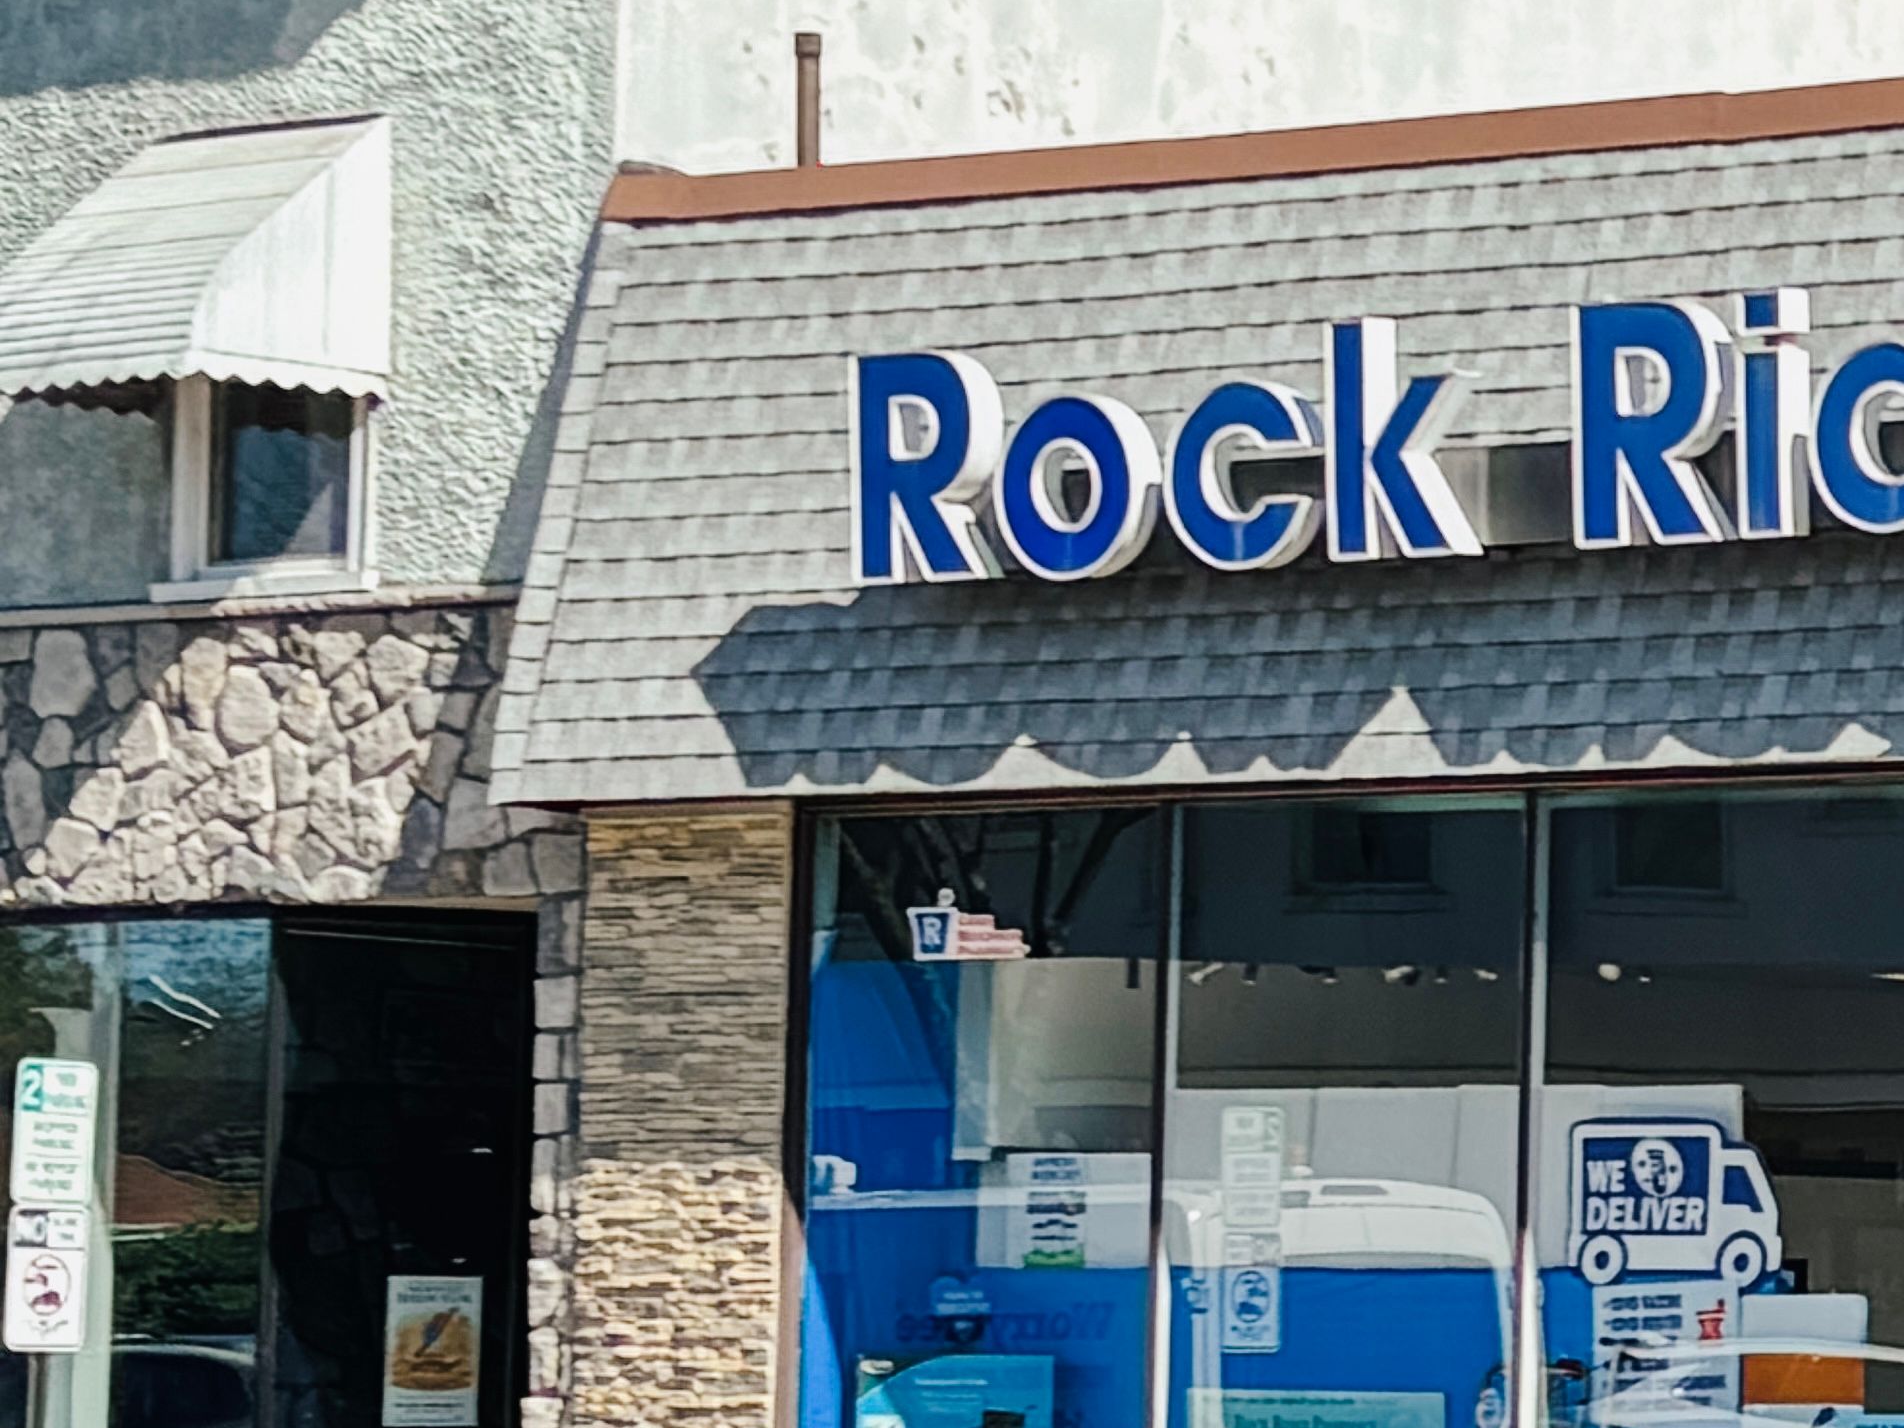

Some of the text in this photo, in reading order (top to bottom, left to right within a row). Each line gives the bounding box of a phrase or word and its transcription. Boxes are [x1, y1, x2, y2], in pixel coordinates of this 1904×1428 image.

[848, 316, 1484, 584] Rock
[1586, 1159, 1627, 1193] WE
[1585, 1196, 1705, 1231] DELIVER
